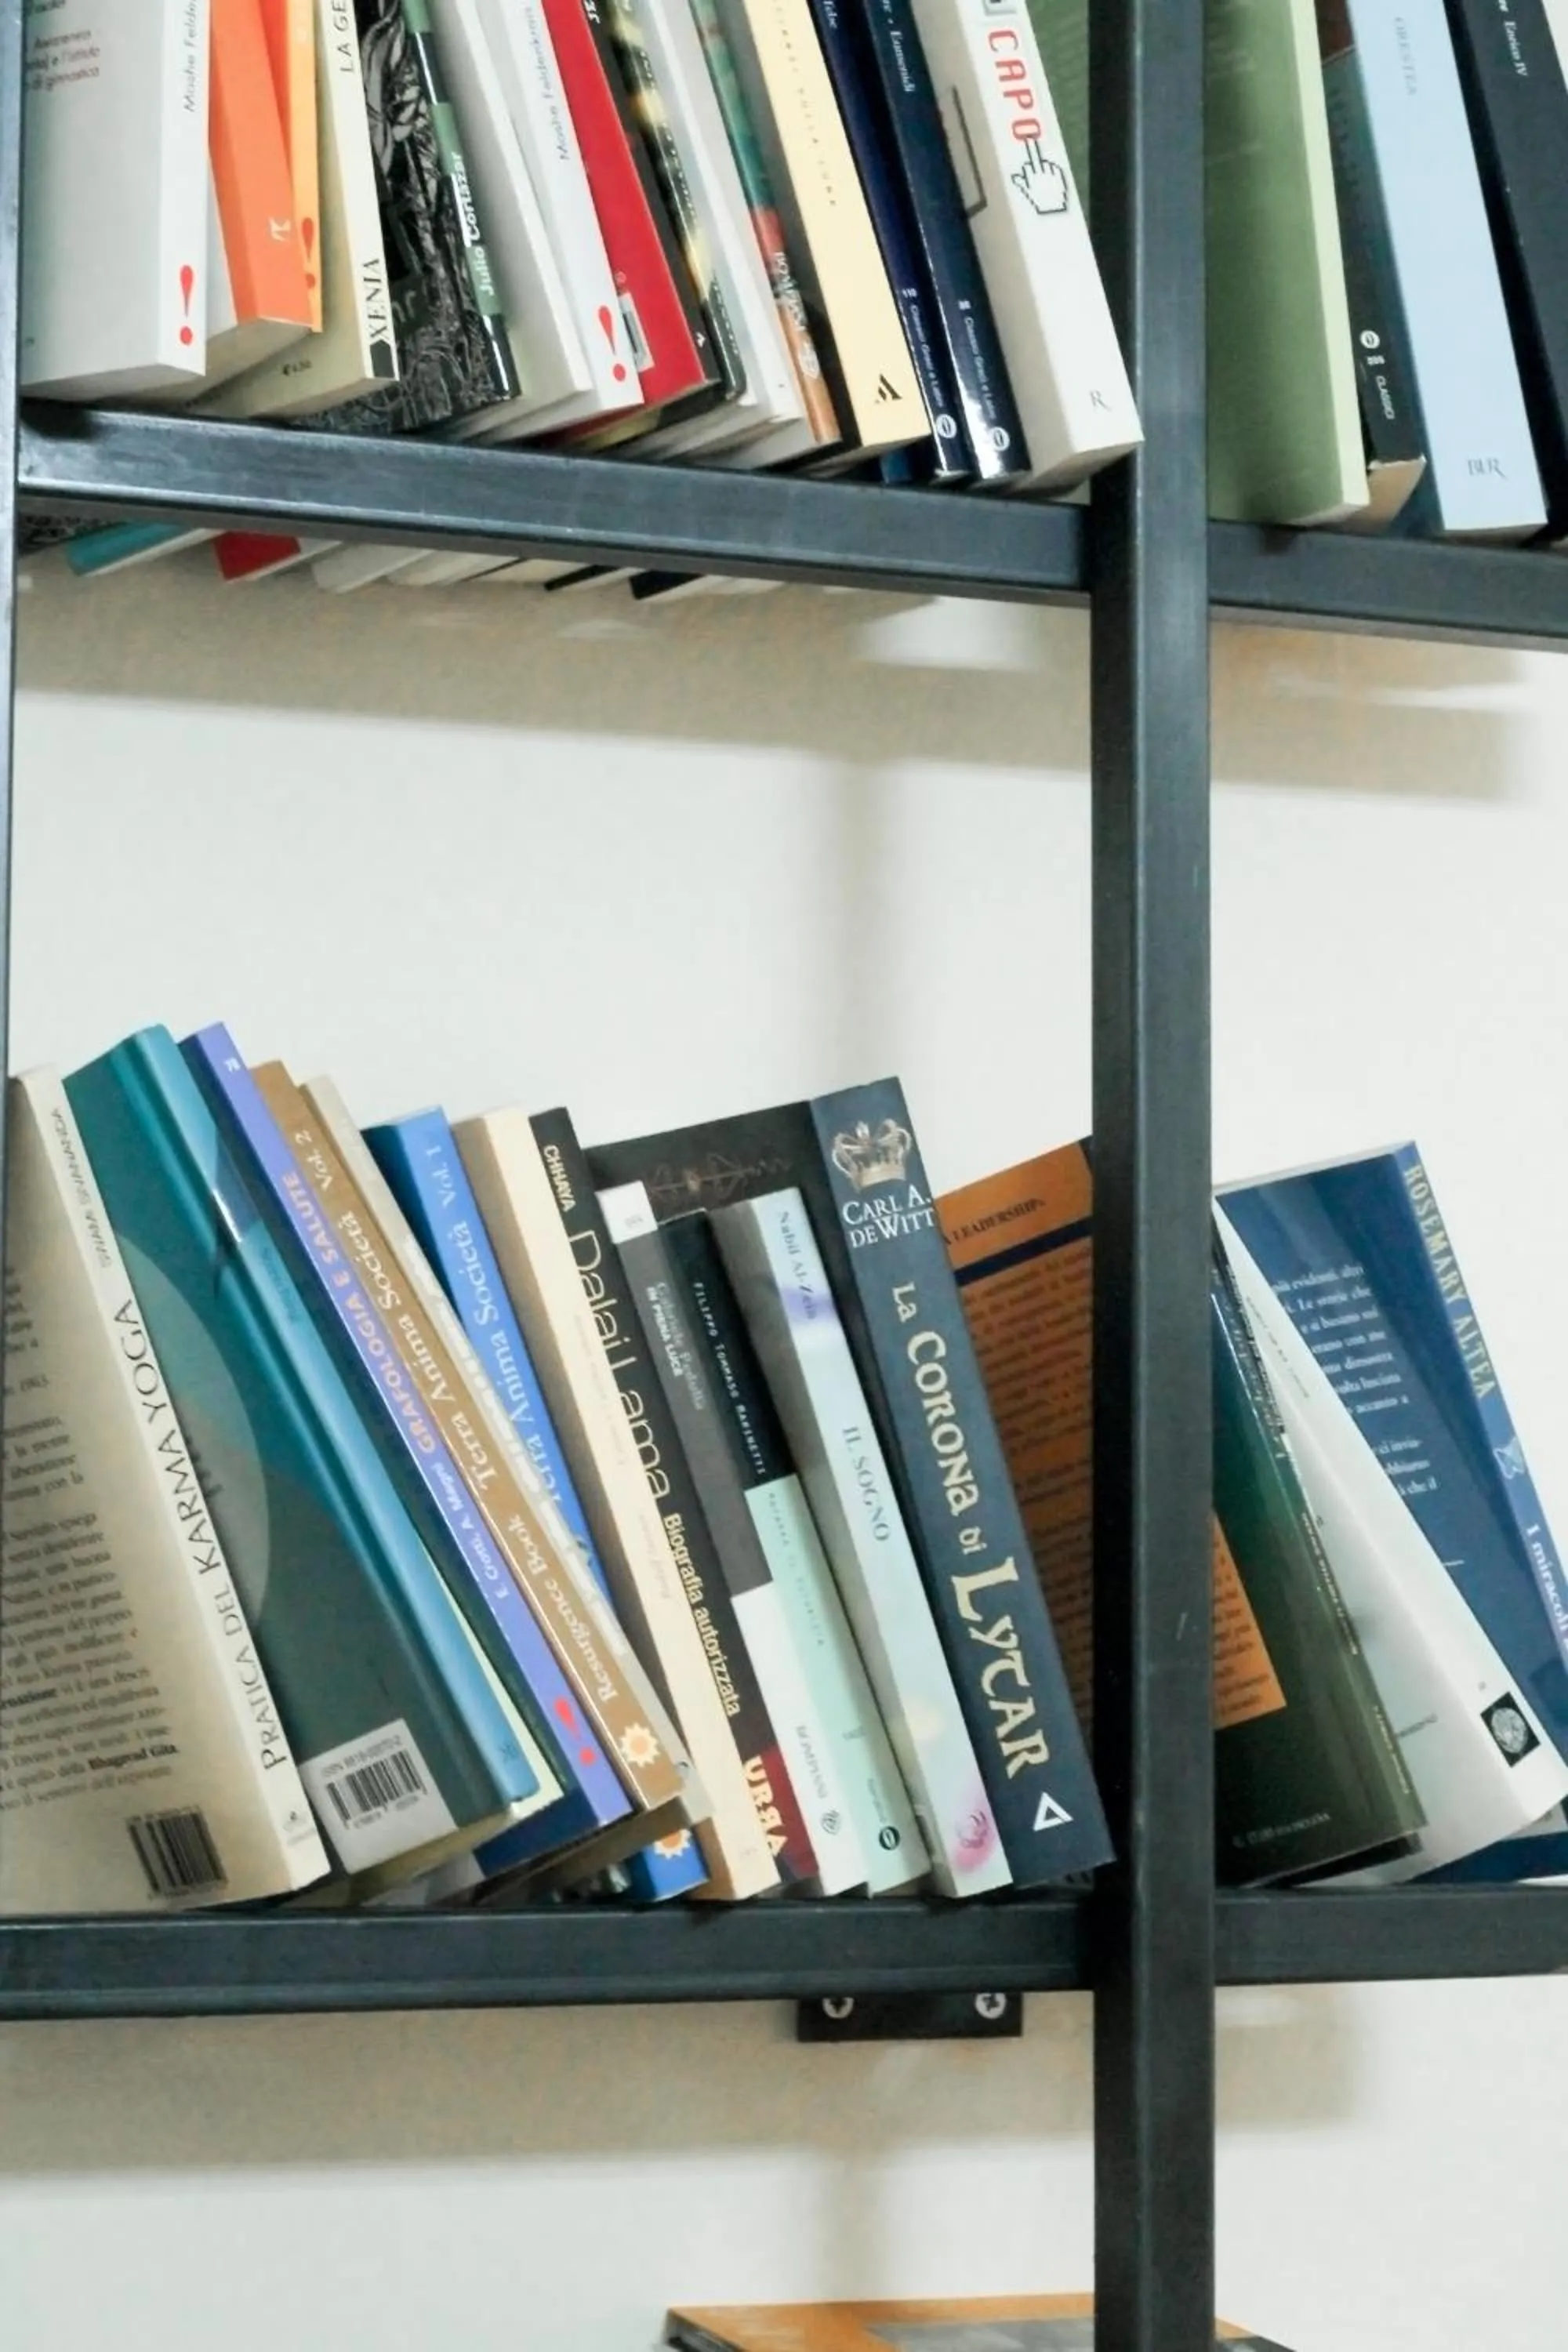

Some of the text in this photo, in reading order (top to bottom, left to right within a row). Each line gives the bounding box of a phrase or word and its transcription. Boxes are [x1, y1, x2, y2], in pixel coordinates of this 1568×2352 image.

[337, 42, 355, 73] LA
[1504, 20, 1521, 61] Enrico
[988, 29, 1042, 141] CAPO
[363, 258, 388, 340] XENIA
[473, 246, 495, 296] Julio
[295, 1129, 334, 1191] Vol. 2
[425, 1145, 456, 1208] Vol. 1
[543, 1145, 576, 1214] CHHAYA
[777, 1209, 801, 1256] Nabil
[842, 1183, 932, 1225] CARL A.
[281, 1171, 437, 1455] GRAFOLOGIA E SALUTE
[446, 1220, 500, 1327] Società
[891, 1281, 917, 1323] La
[1404, 1163, 1497, 1399] ROSEMARY ALTEA
[337, 1210, 499, 1490] Terra Anima Società
[490, 1330, 536, 1423] Anima
[568, 1229, 630, 1344] Dalai
[611, 1356, 671, 1498] Lama
[735, 1403, 767, 1477] MARINETTI
[843, 1424, 891, 1544] IL SOGNO
[114, 1298, 289, 1771] PRATICA DEL KARMA YOGA
[1526, 1523, 1568, 1633] I miracoli
[495, 1584, 510, 1600] E.
[507, 1513, 619, 1705] Resurgence Book
[662, 1512, 740, 1717] Biografia autorizzata
